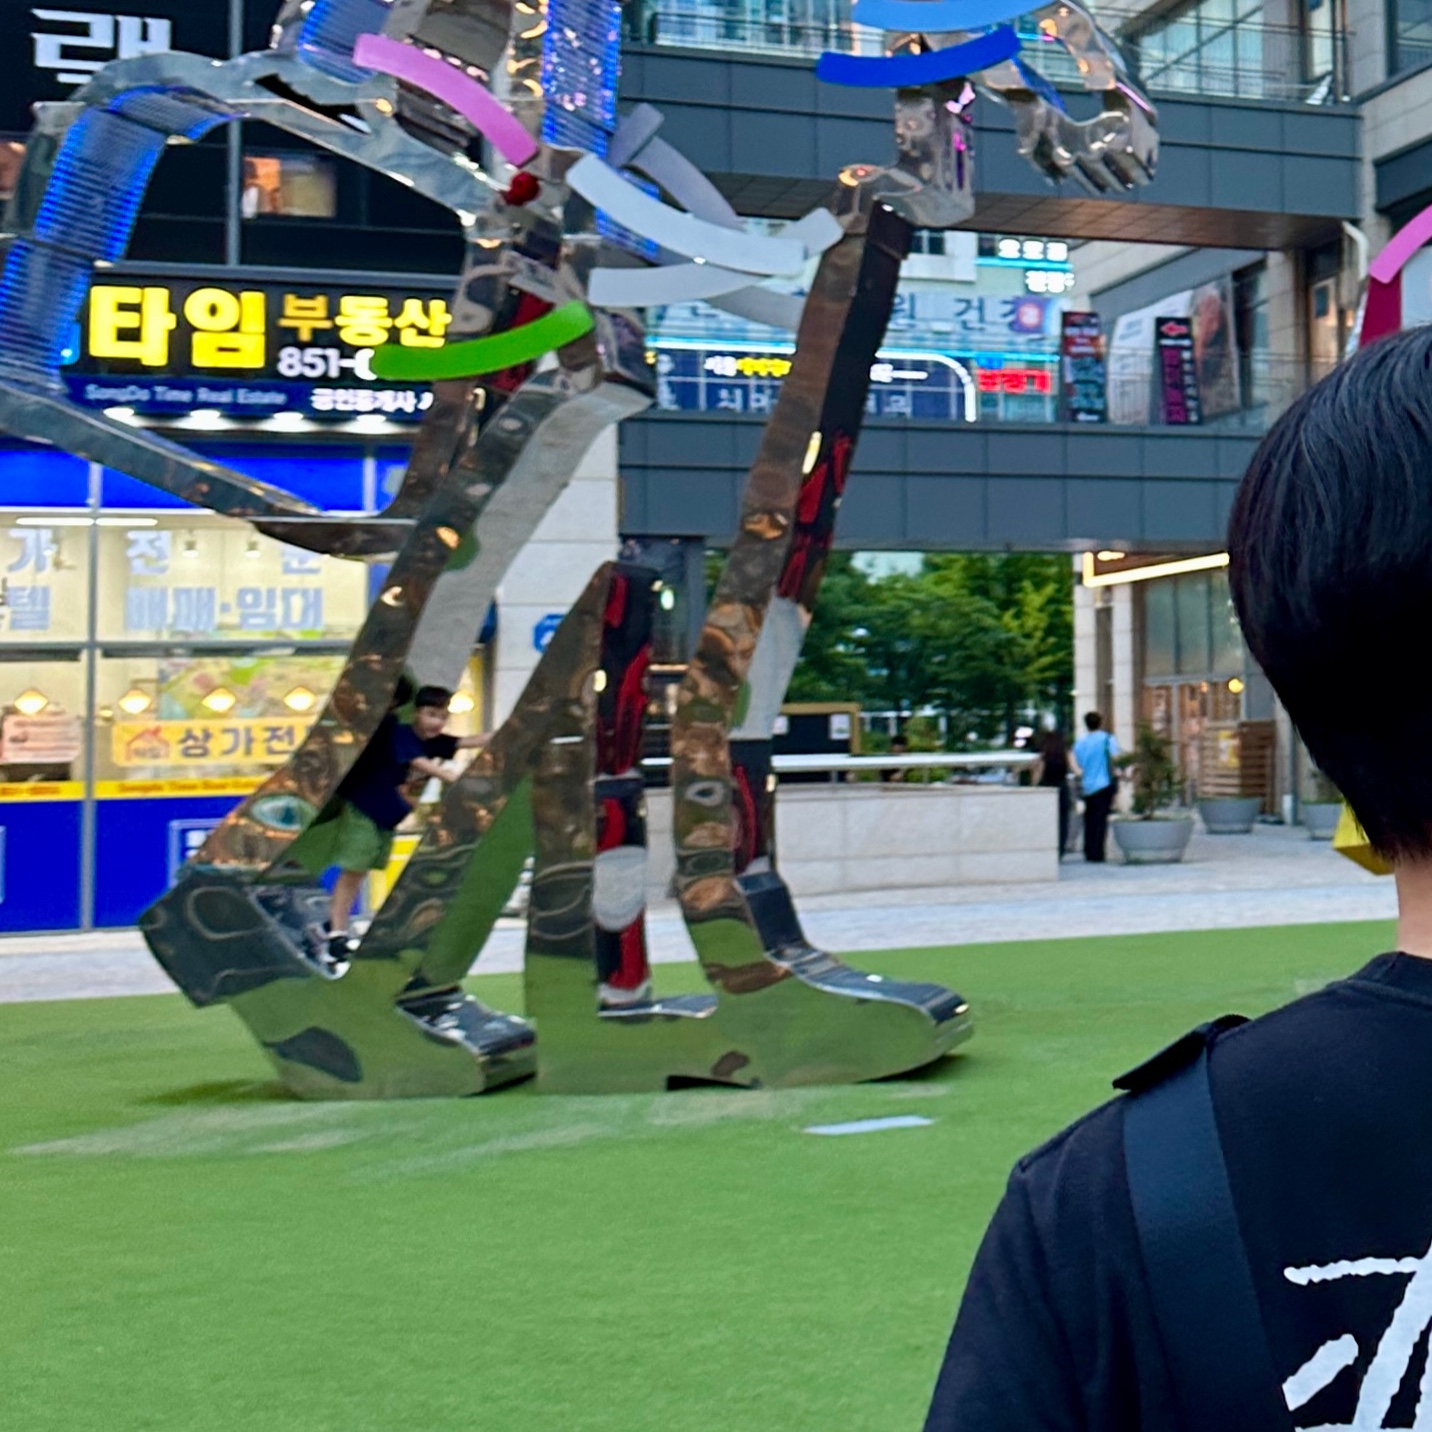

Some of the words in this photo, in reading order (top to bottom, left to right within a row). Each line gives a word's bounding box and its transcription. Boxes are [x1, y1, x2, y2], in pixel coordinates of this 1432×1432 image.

[88, 285, 266, 368] 타임
[276, 293, 453, 348] 부동산
[178, 725, 312, 758] 상가전
